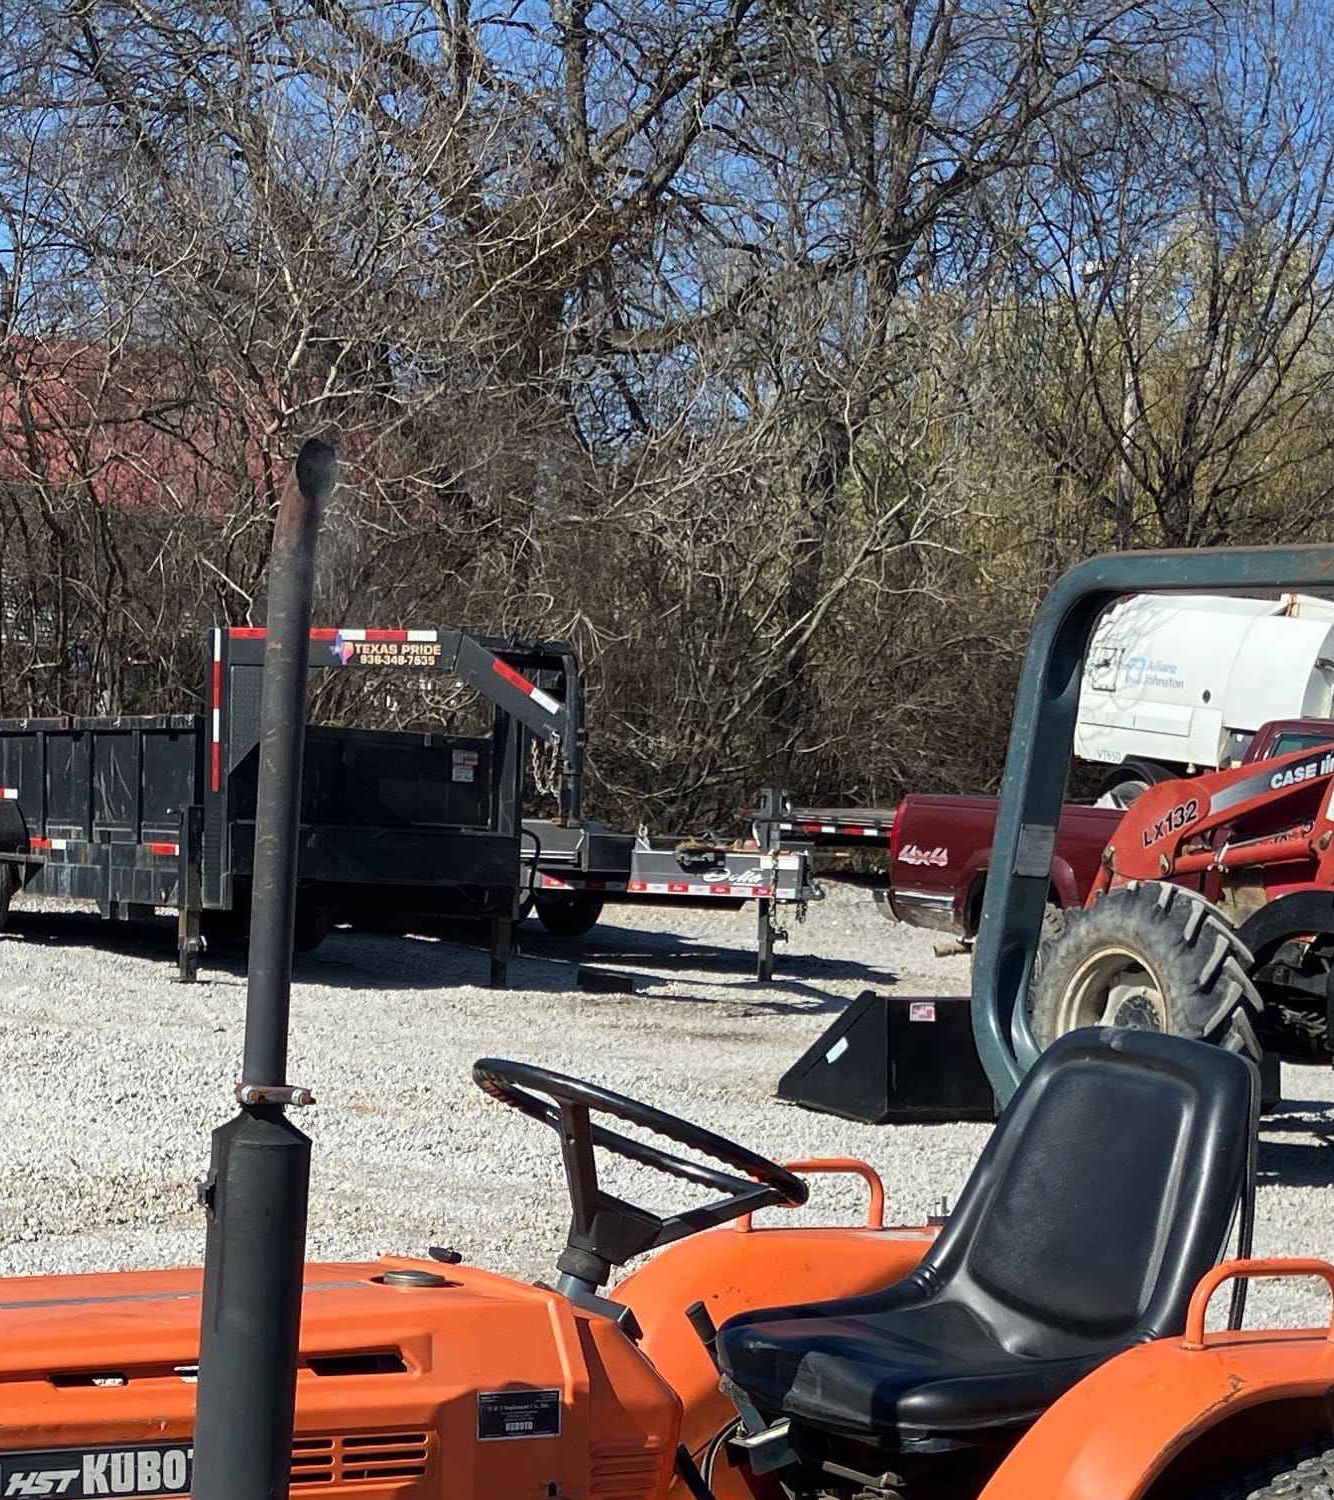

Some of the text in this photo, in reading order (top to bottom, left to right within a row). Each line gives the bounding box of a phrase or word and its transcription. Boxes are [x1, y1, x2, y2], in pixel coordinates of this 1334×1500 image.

[354, 643, 442, 656] TEXAS PRIDE
[1146, 660, 1178, 674] Allianz
[1144, 674, 1185, 689] Johnston
[1270, 763, 1318, 790] CASE
[4, 1469, 81, 1497] HST
